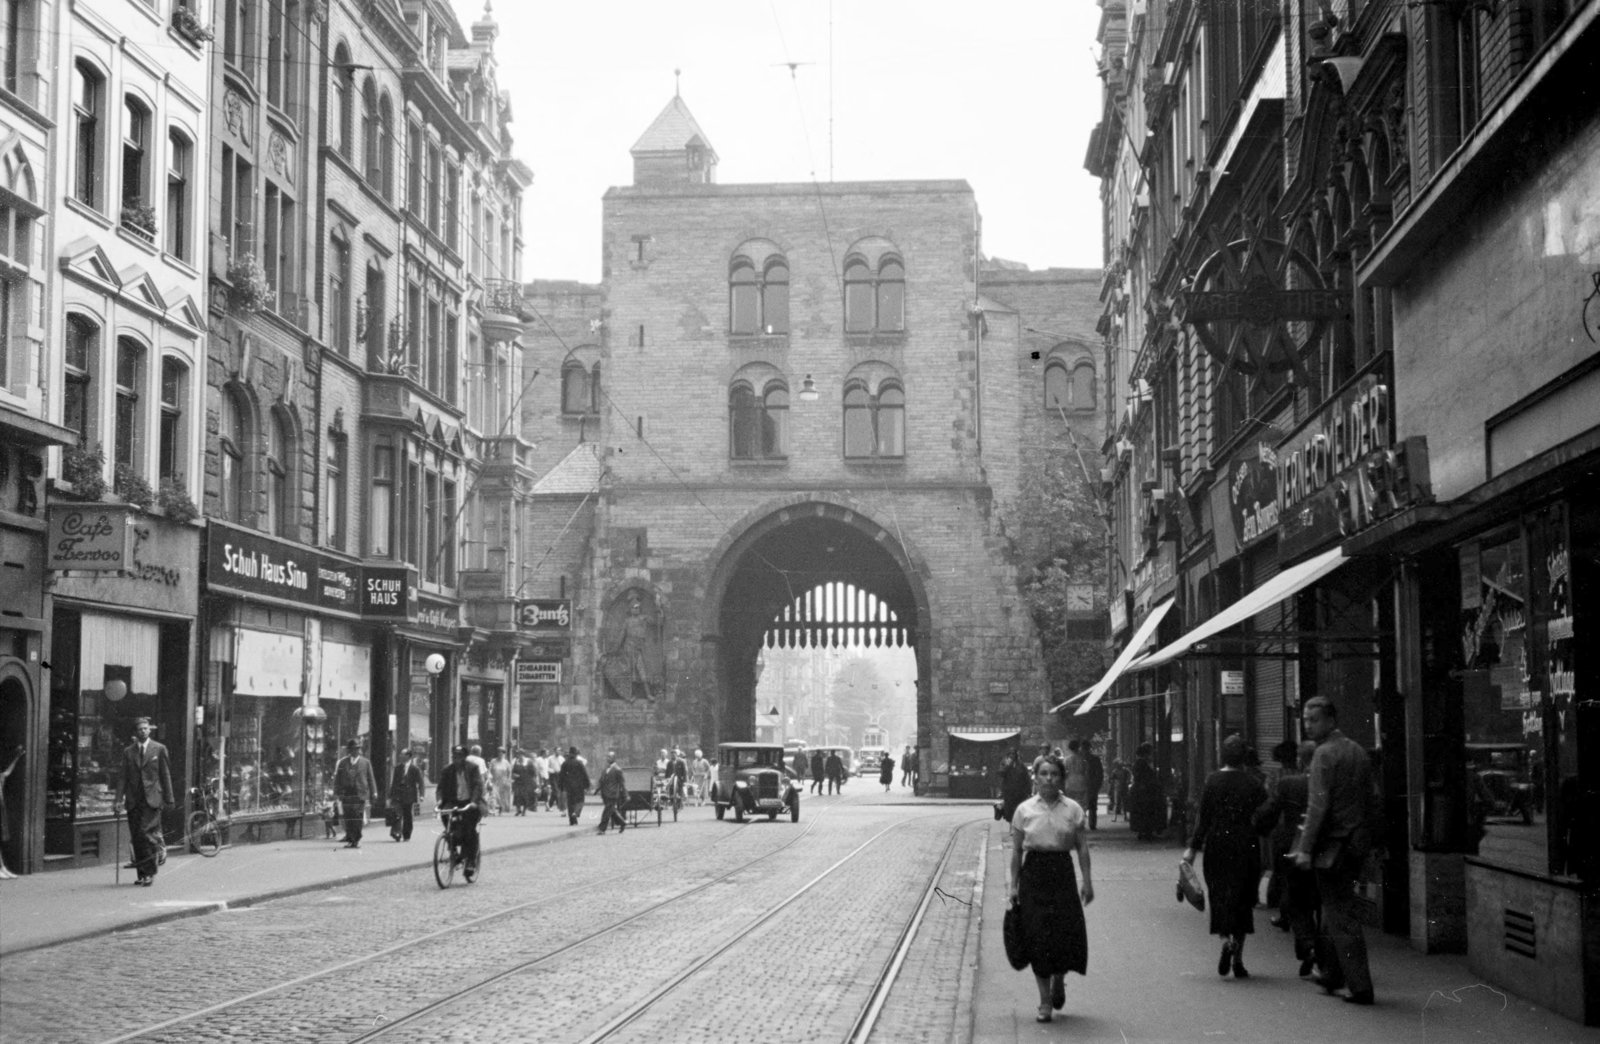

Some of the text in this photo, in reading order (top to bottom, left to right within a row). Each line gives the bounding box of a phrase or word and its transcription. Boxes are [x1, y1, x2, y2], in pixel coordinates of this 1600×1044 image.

[1323, 385, 1381, 483] MELDER
[222, 543, 258, 578] Schuh
[260, 553, 286, 585] Haus
[286, 560, 308, 590] Sinn
[367, 578, 401, 591] SCHUH
[370, 592, 398, 605] HAUS
[523, 604, 569, 626] Zuntz
[518, 664, 557, 672] ZIGARREN
[518, 672, 556, 680] ZIGARETTEN
